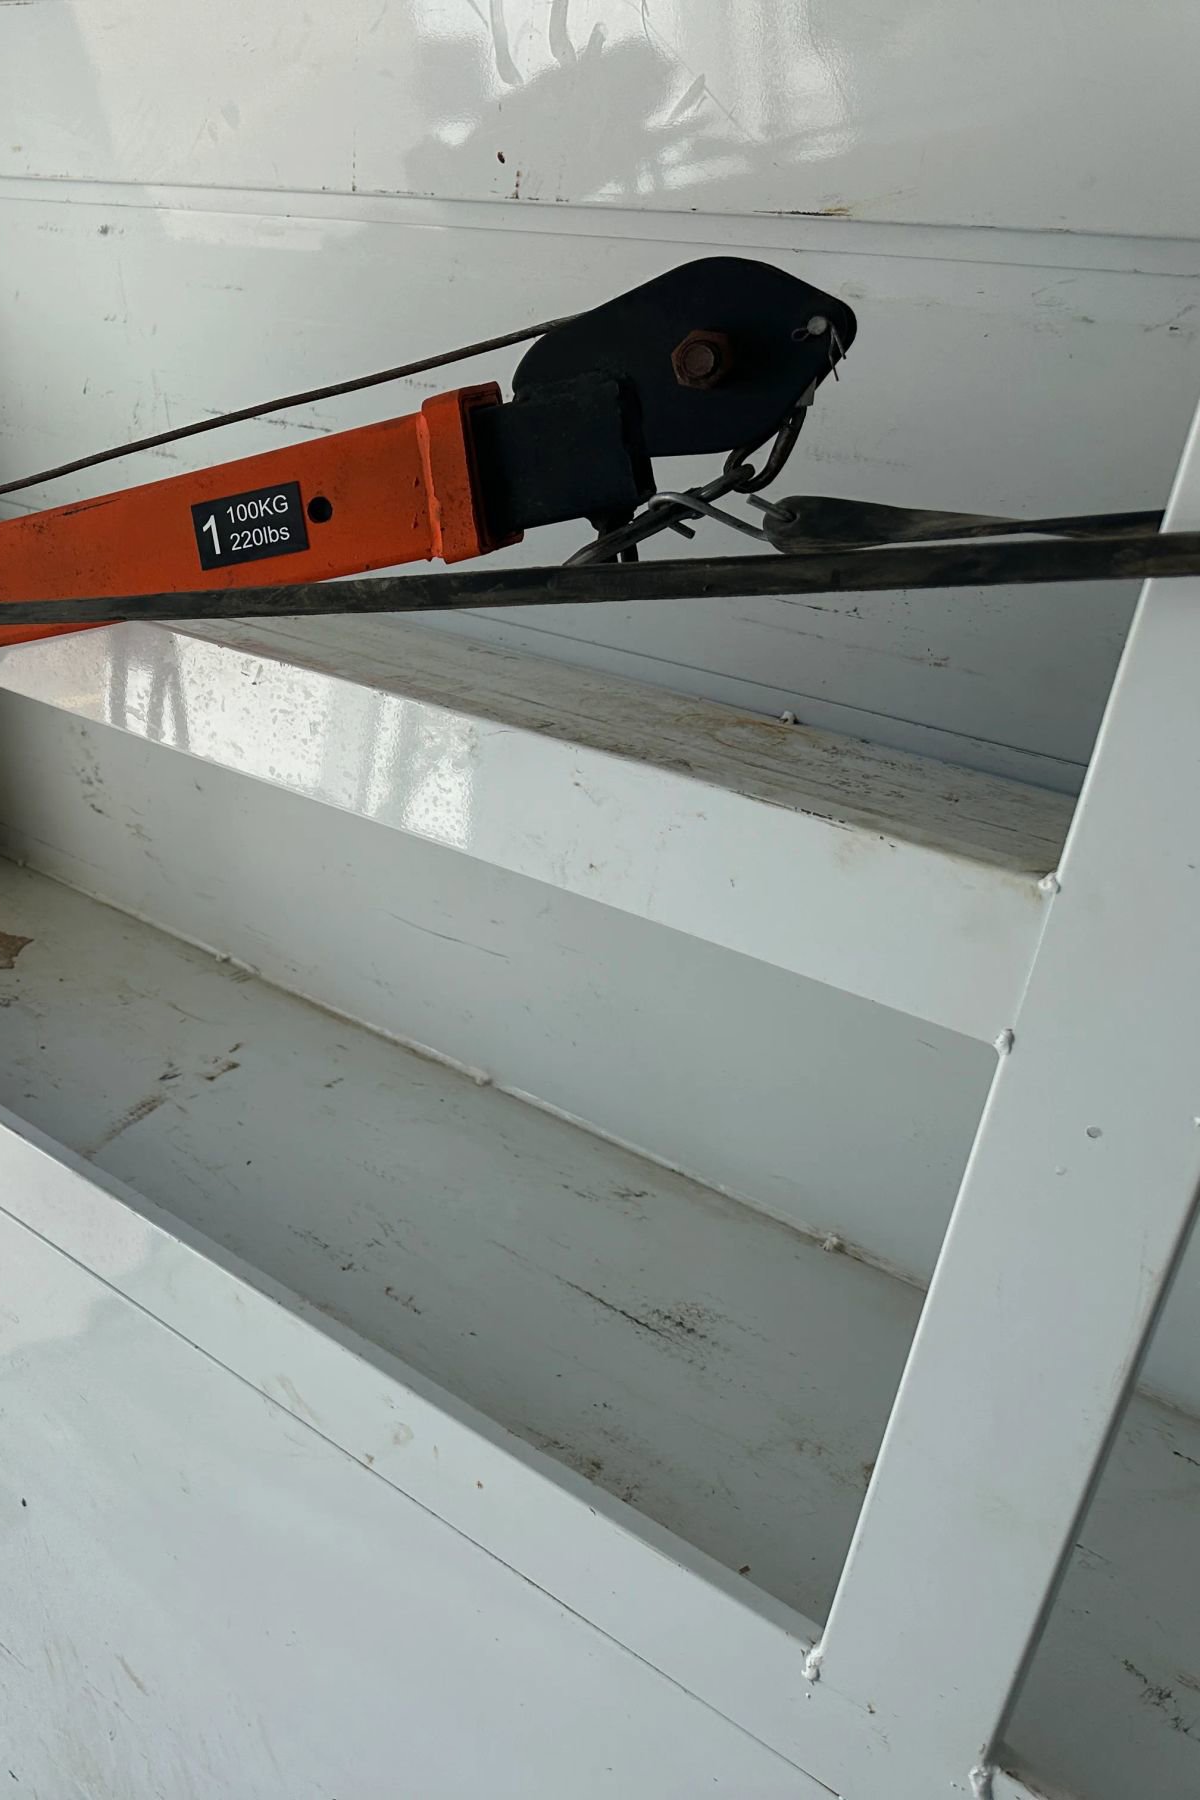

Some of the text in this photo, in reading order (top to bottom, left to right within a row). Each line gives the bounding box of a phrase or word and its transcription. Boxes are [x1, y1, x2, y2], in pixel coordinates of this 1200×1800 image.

[226, 494, 289, 524] 100KG
[202, 514, 221, 555] 1
[230, 525, 290, 551] 220lbs
